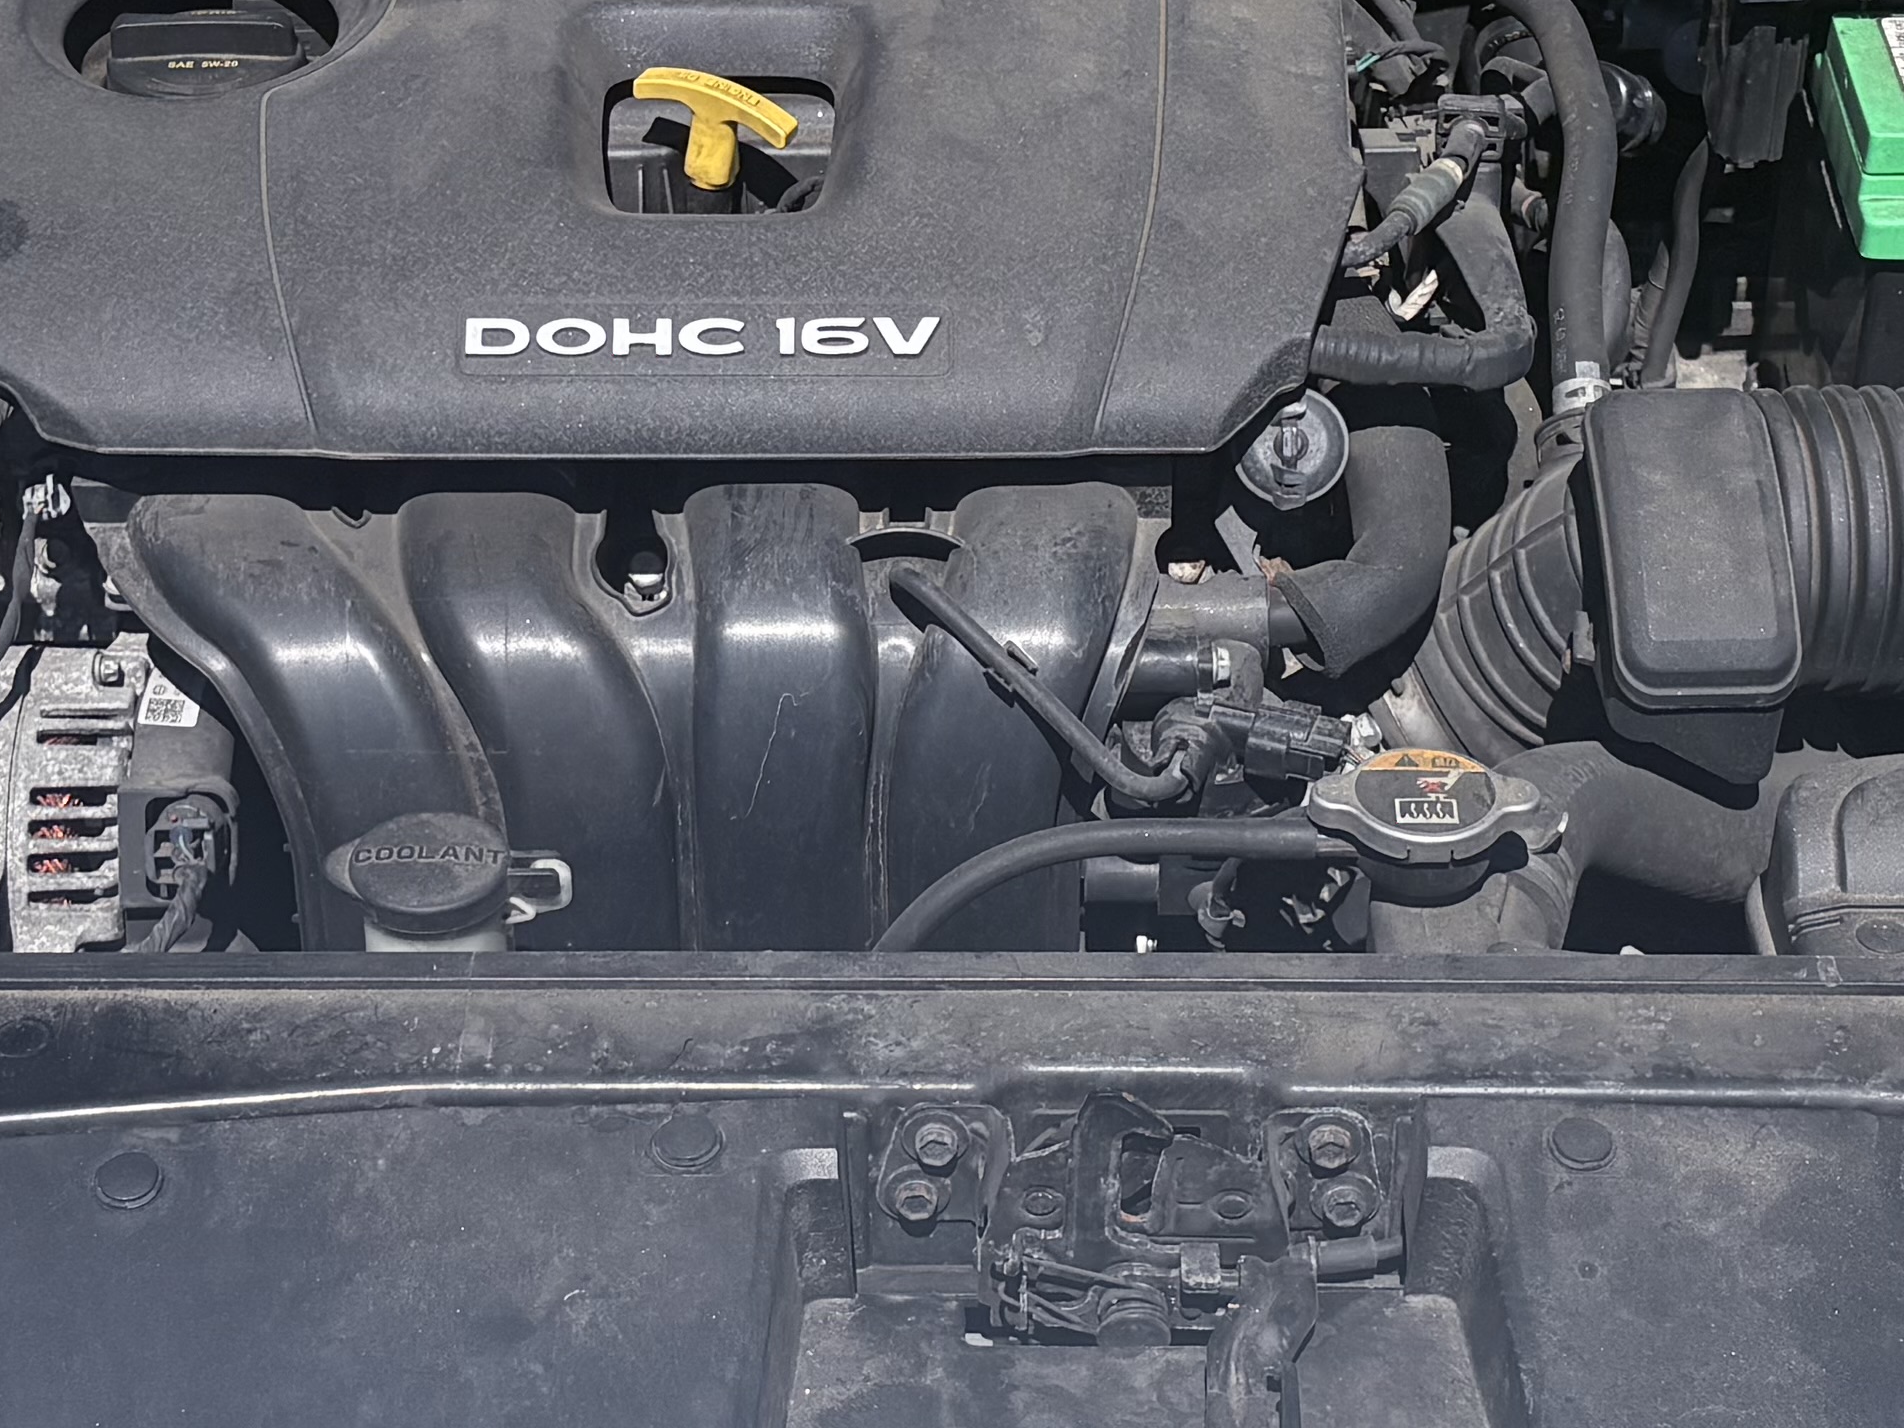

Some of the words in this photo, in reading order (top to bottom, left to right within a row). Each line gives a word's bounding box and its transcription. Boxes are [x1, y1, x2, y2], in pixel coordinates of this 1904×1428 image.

[167, 60, 195, 69] SAE
[464, 316, 746, 357] DOHC
[776, 316, 941, 357] 16V
[353, 844, 506, 865] COOLANT
